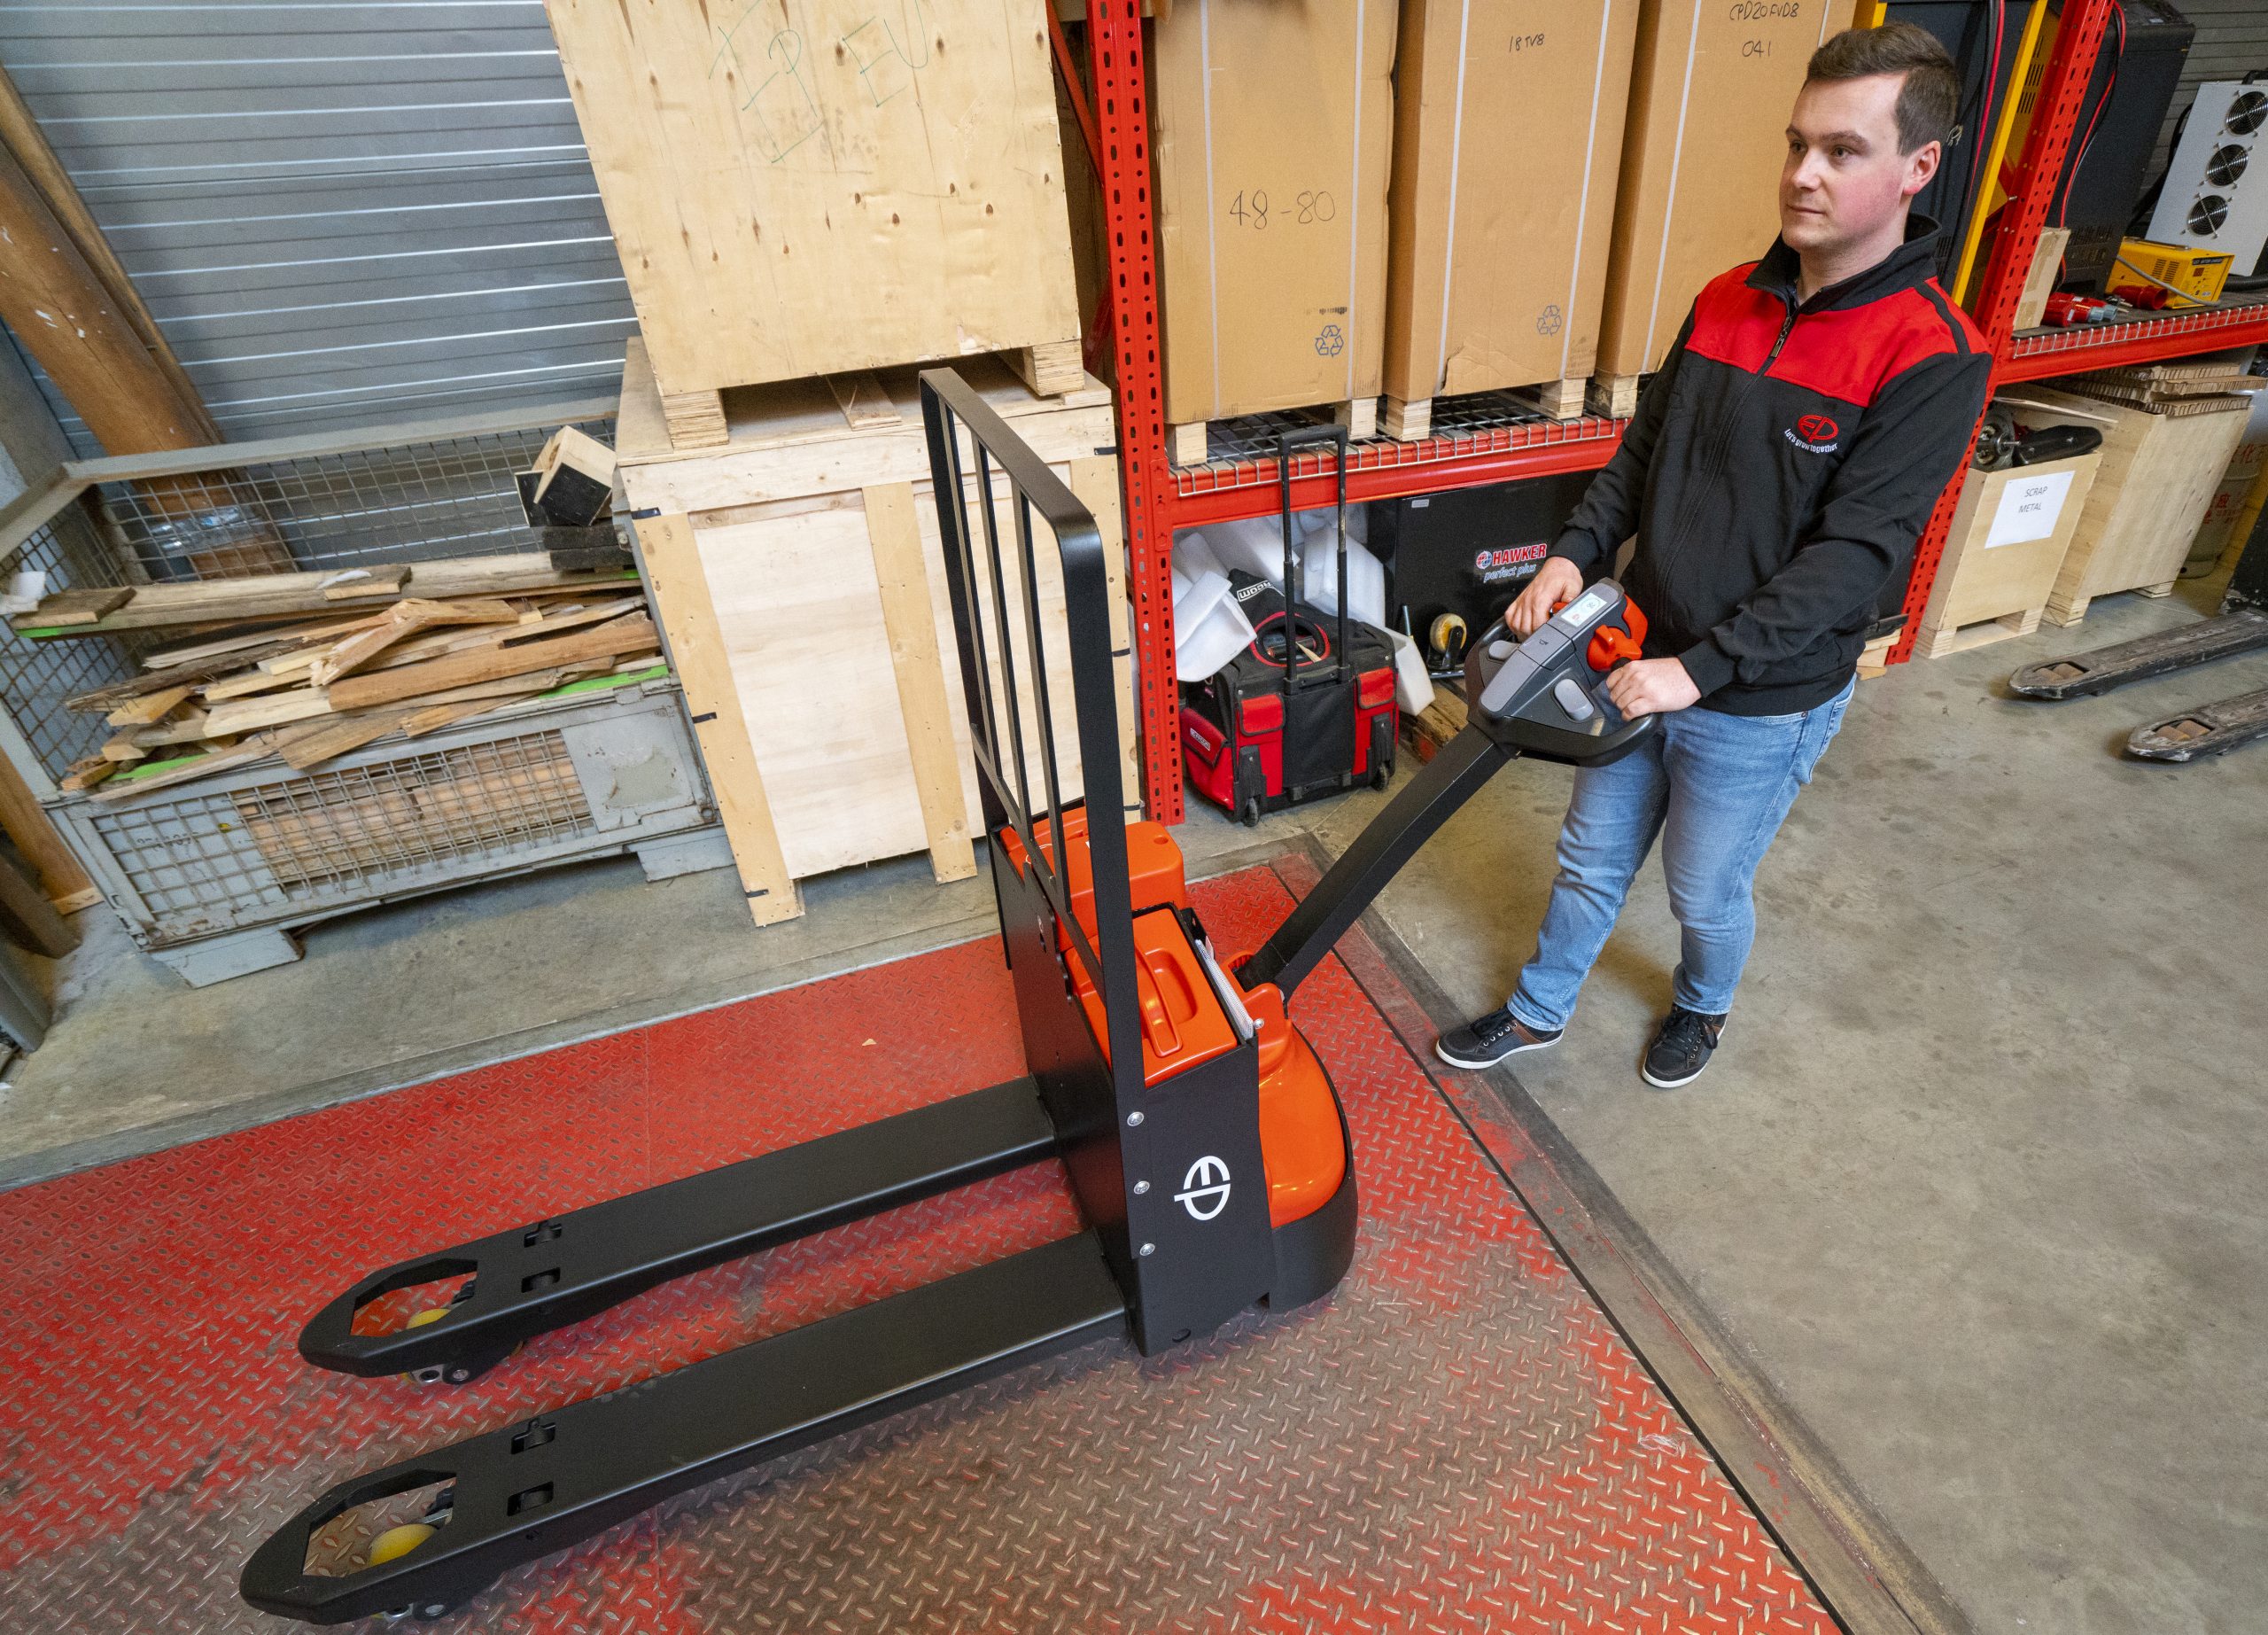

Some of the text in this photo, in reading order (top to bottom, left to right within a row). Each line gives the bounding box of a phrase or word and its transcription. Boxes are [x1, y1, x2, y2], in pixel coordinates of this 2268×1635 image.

[1742, 39, 1771, 58] 041
[2023, 486, 2048, 498] SCRAP
[2018, 502, 2042, 513] METAL
[1492, 543, 1547, 566] HAWKER
[1483, 562, 1537, 584] perfect plus
